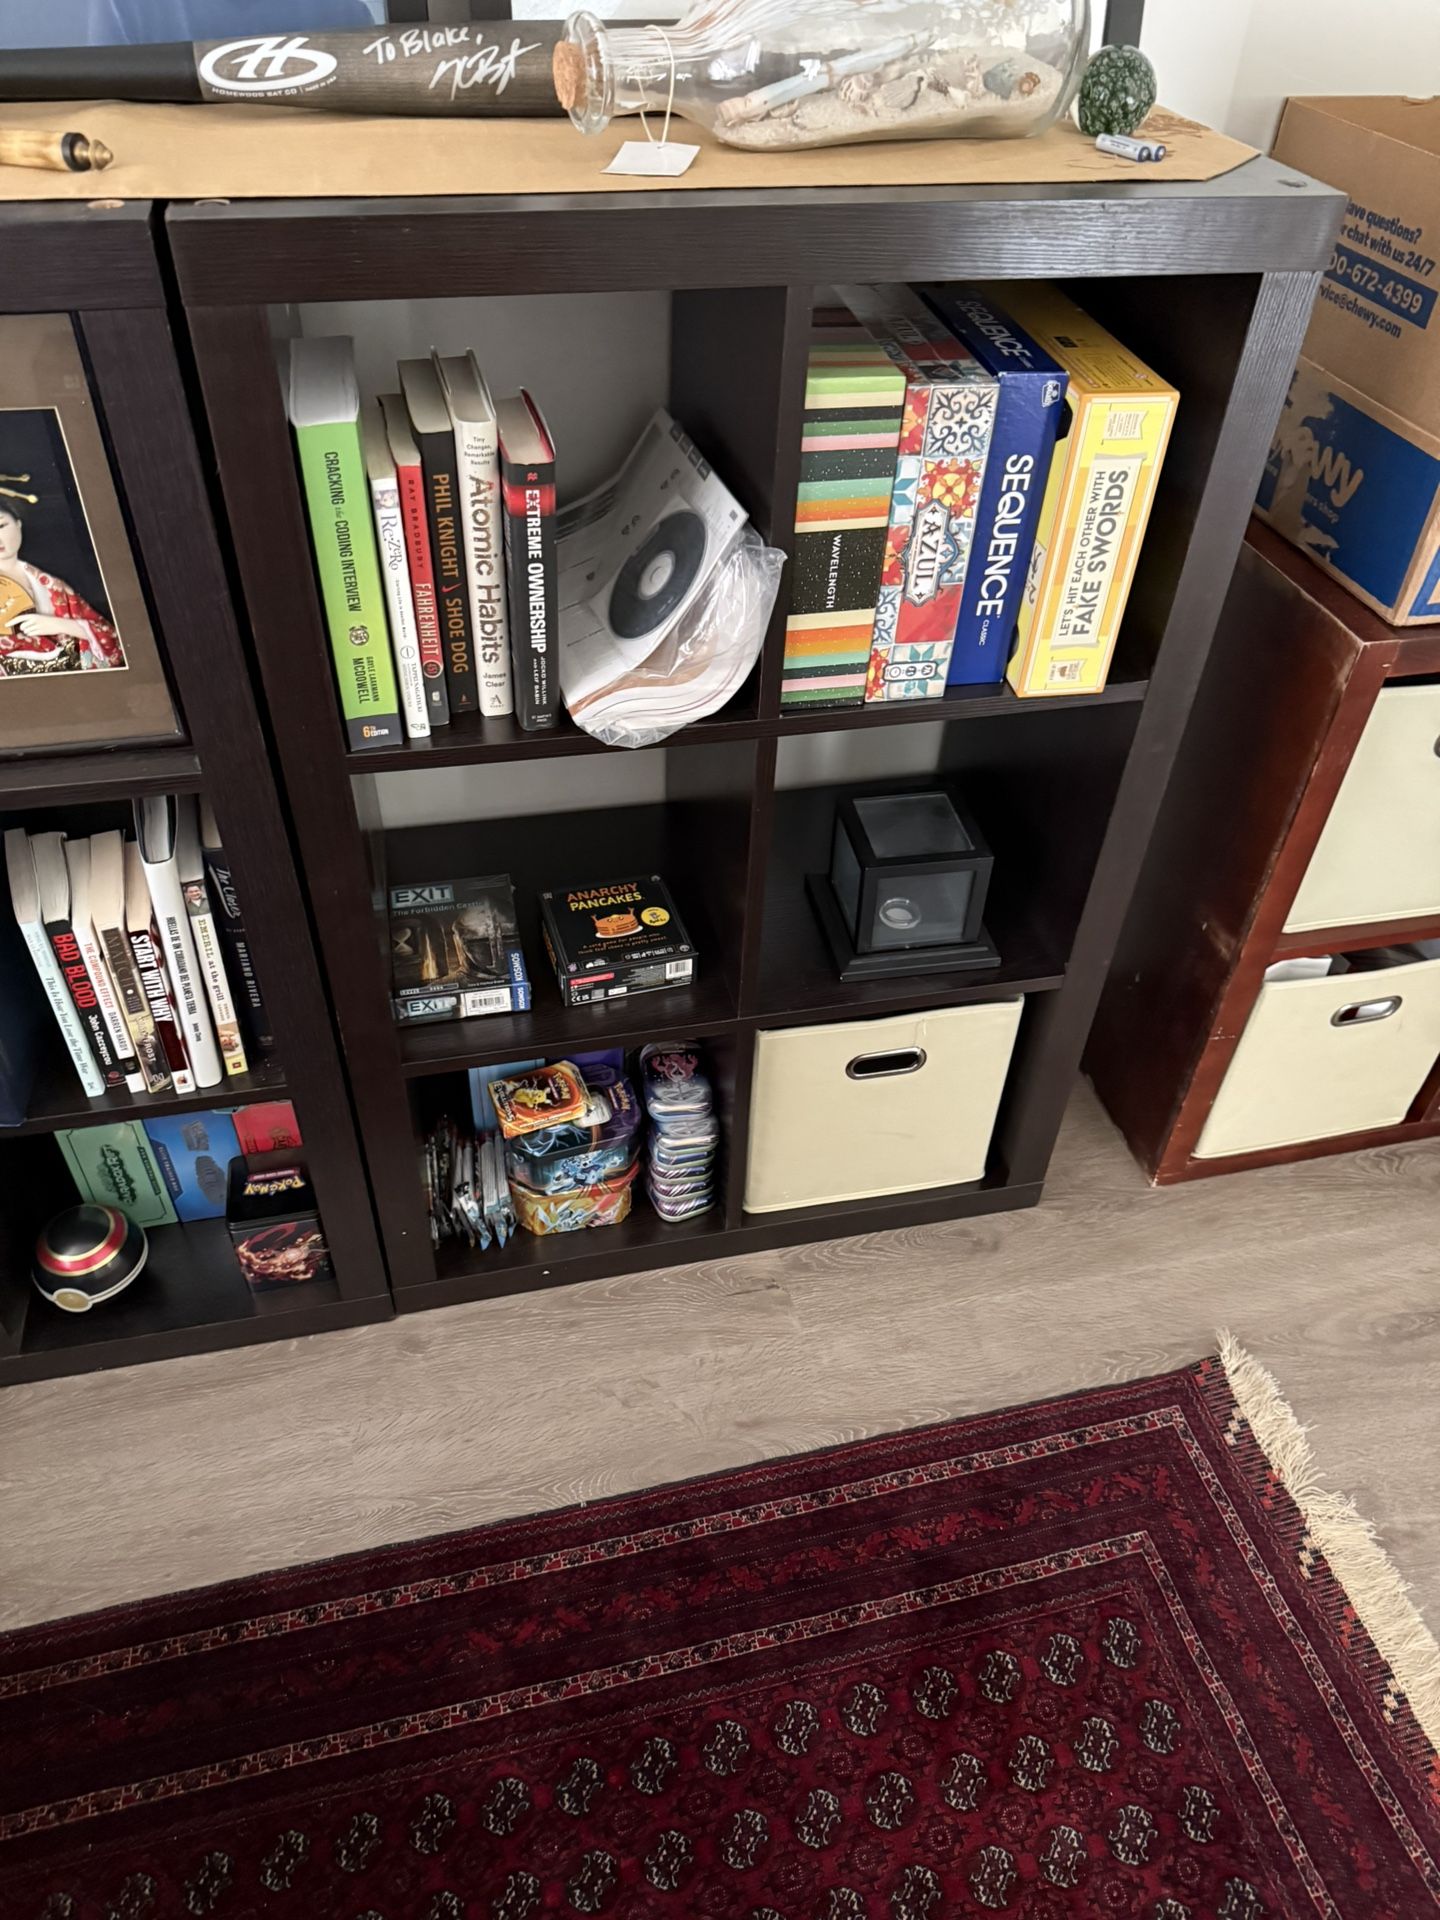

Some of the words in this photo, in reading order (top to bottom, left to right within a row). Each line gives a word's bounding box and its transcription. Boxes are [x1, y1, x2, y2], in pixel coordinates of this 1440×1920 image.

[362, 36, 396, 65] To
[400, 26, 484, 58] Blake,
[211, 87, 265, 98] HOMEWOOD
[284, 88, 298, 96] CO
[1366, 210, 1423, 245] questions?
[1347, 223, 1371, 248] chat
[1370, 235, 1392, 258] with
[1391, 250, 1406, 265] us
[1404, 250, 1437, 277] 24/7
[955, 299, 1033, 358] SEQUENCE
[324, 451, 346, 505] CRACKING
[408, 479, 416, 501] RAY
[433, 473, 450, 513] PHIL
[1089, 470, 1106, 505] WITH
[335, 519, 354, 558] CODING
[410, 508, 424, 569] BRADBURY
[468, 474, 498, 576] Atomic
[525, 489, 542, 559] EXTREME
[976, 453, 1035, 617] SEQUENCE
[1080, 507, 1098, 548] OTHER
[437, 516, 459, 577] KNIGHT
[913, 519, 942, 589] AZUL
[1071, 581, 1102, 635] FAKE
[1087, 470, 1129, 573] SWORDS
[826, 534, 843, 609] WAVELENGTH
[1071, 551, 1088, 583] EACH
[341, 559, 363, 612] INTERVIEW
[1069, 588, 1079, 607] HIT
[415, 583, 440, 656] FAHRENHEIT
[446, 597, 465, 638] SHOE
[476, 584, 504, 664] Habits
[528, 562, 547, 654] OWNERSHIP
[1059, 609, 1074, 637] LET'S
[978, 619, 990, 647] CLASSIC
[366, 656, 376, 673] GAYLE
[451, 642, 469, 674] DOG
[370, 728, 390, 738] EDITION
[216, 865, 229, 889] The
[223, 887, 242, 918] Closer
[395, 886, 450, 904] EXIT
[567, 882, 639, 903] ANARCHY
[570, 891, 642, 912] PANCAKES
[393, 909, 409, 917] The
[410, 903, 455, 915] Forbidden
[53, 932, 81, 963] BAD
[84, 942, 94, 955] THE
[130, 935, 158, 968] START
[198, 918, 214, 959] EMERIL
[88, 954, 105, 987] COMPOUND
[208, 960, 216, 969] at
[211, 970, 221, 983] the
[235, 941, 253, 978] MARIANO
[246, 977, 262, 1008] RIVERA
[510, 952, 525, 982] KOSMOS
[64, 963, 97, 1009] BLOOD
[99, 984, 114, 1009] EFFECT
[141, 969, 167, 998] WITH
[212, 984, 225, 1002] grill
[88, 1014, 101, 1031] John
[107, 1011, 122, 1034] DARREN
[150, 998, 174, 1022] WHY
[115, 1031, 129, 1052] HARDY
[144, 1038, 157, 1063] FROST
[111, 1164, 133, 1206] PARADOX
